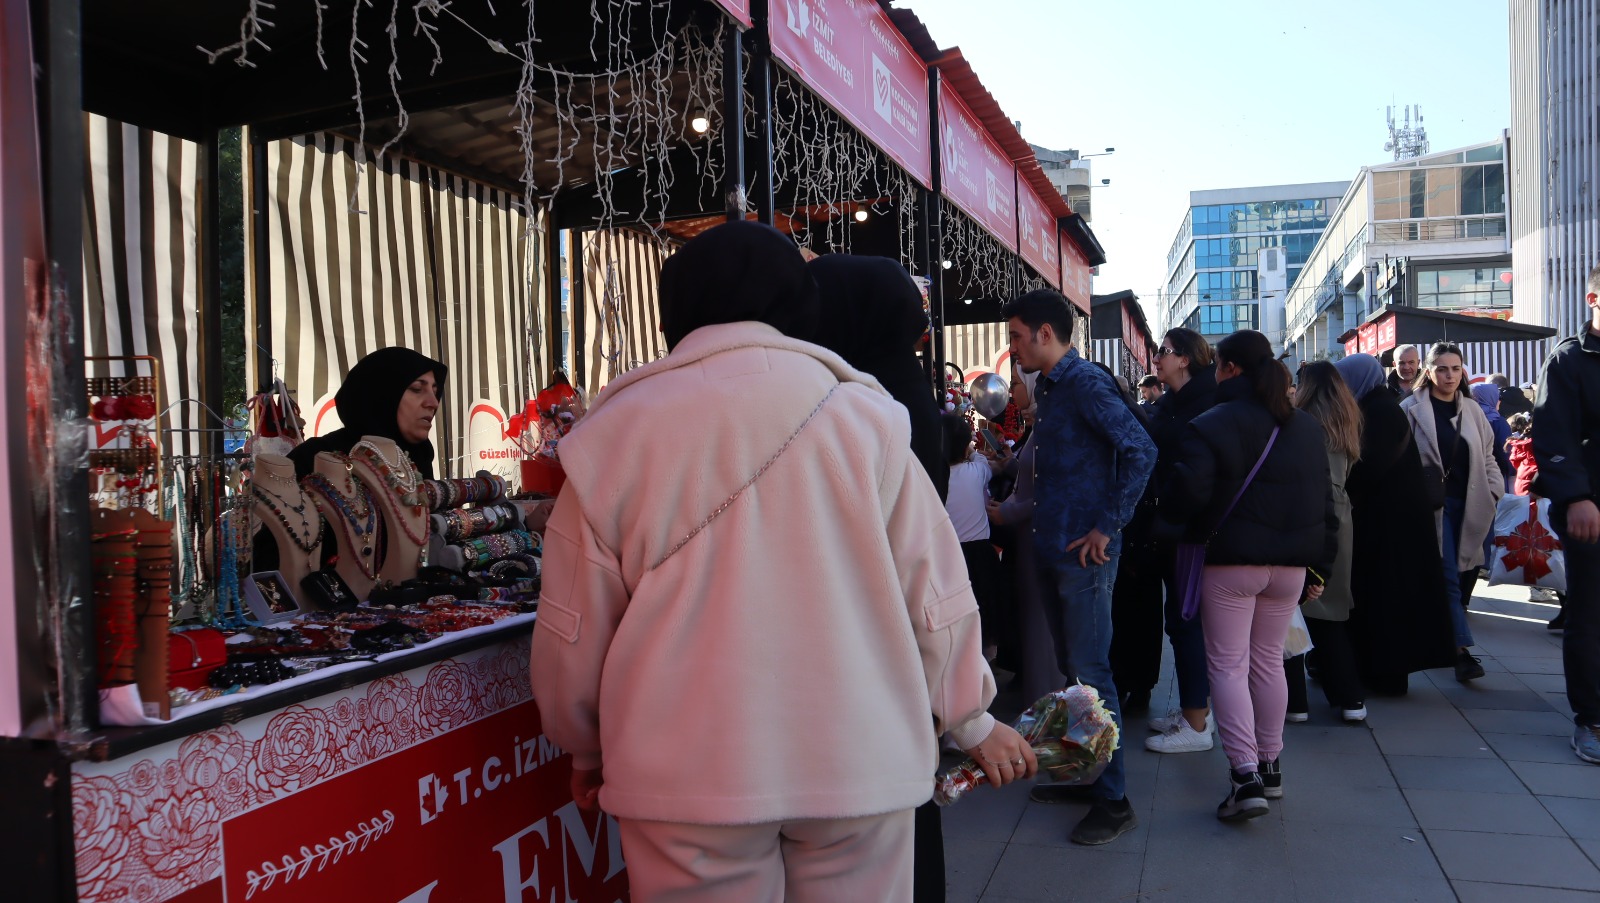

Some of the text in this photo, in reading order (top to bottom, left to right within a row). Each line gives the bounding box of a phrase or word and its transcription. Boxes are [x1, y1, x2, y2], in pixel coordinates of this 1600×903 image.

[812, 6, 835, 46] İZMİT
[813, 36, 854, 90] BELEDİYESİ
[479, 448, 509, 459] Güzel
[453, 756, 511, 806] T.C.
